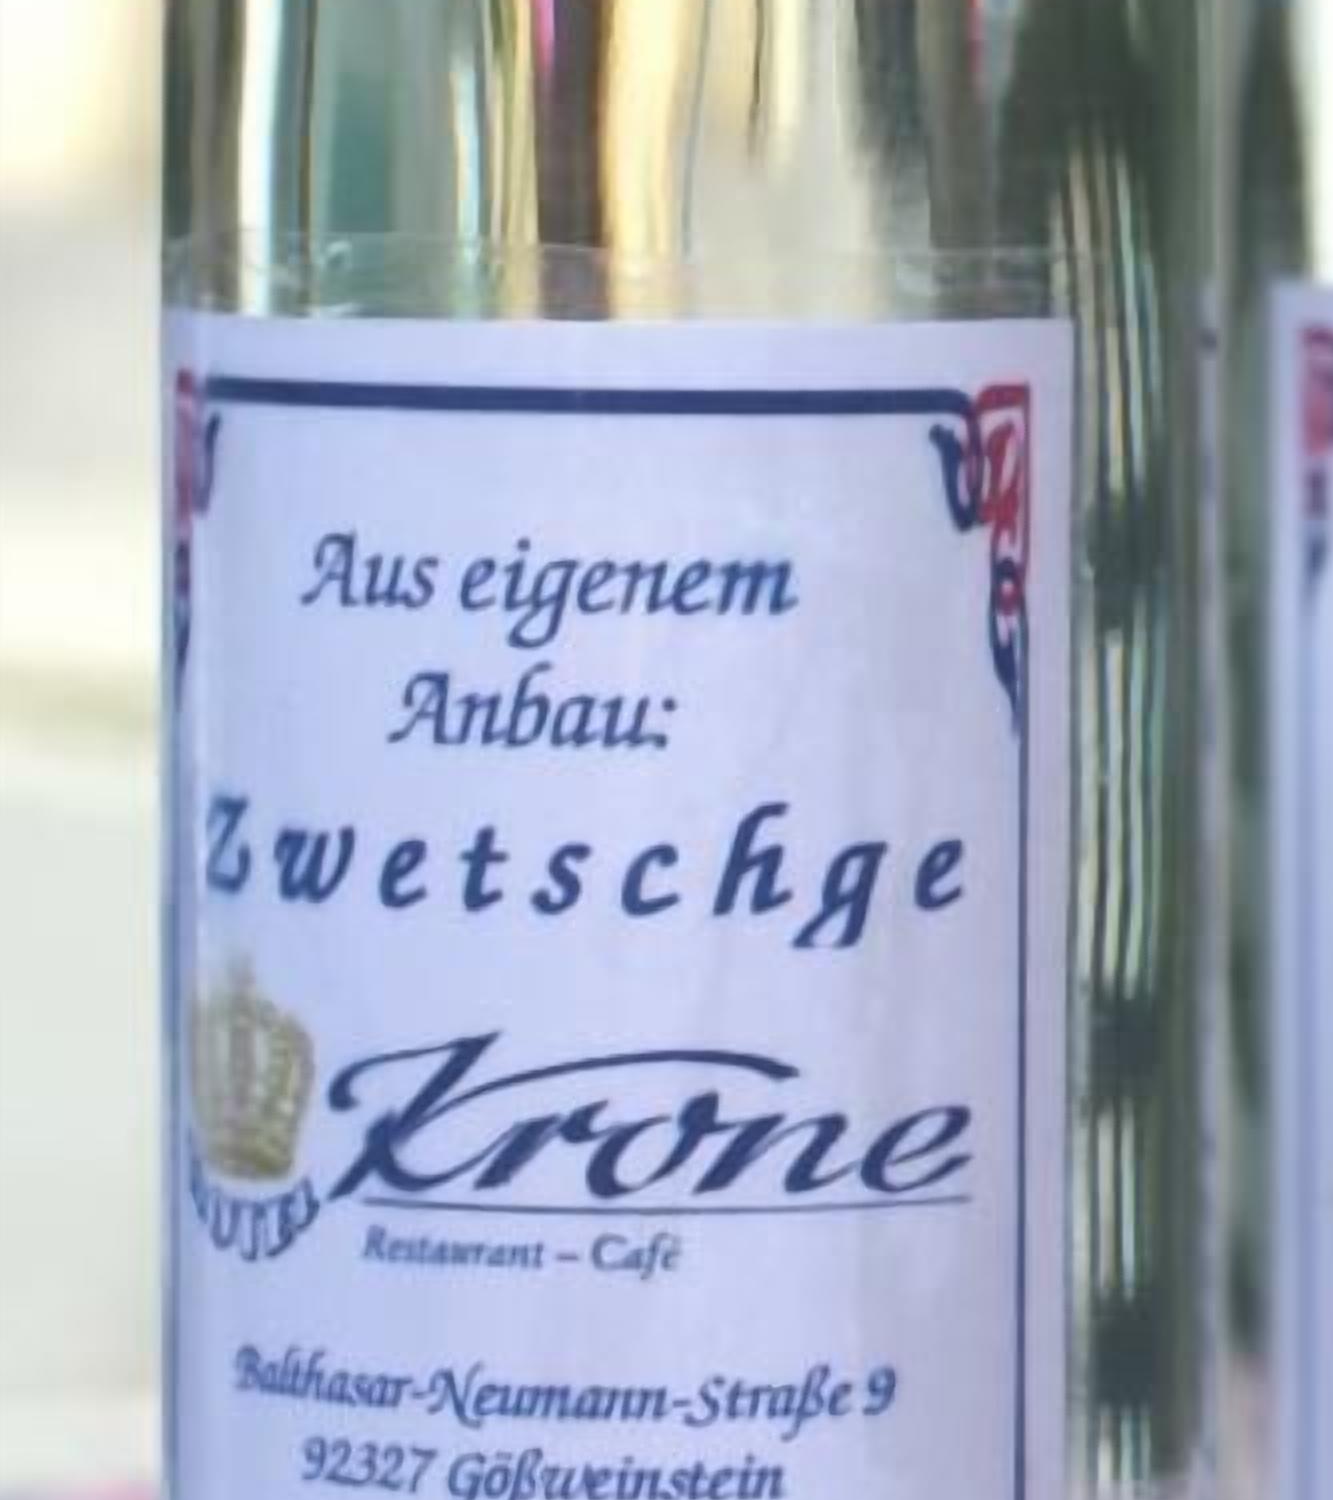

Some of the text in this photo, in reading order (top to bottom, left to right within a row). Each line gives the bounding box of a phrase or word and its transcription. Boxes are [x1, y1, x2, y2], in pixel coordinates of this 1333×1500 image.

[299, 531, 798, 649] Aus eigenem
[386, 664, 677, 748] Anbau:
[205, 794, 964, 949] Zwetschge
[325, 1031, 974, 1205] Krone
[362, 1225, 544, 1272] Restaurant
[233, 1345, 897, 1441] Balthasar-Neumann-Straße 9
[301, 1437, 438, 1493] 92327
